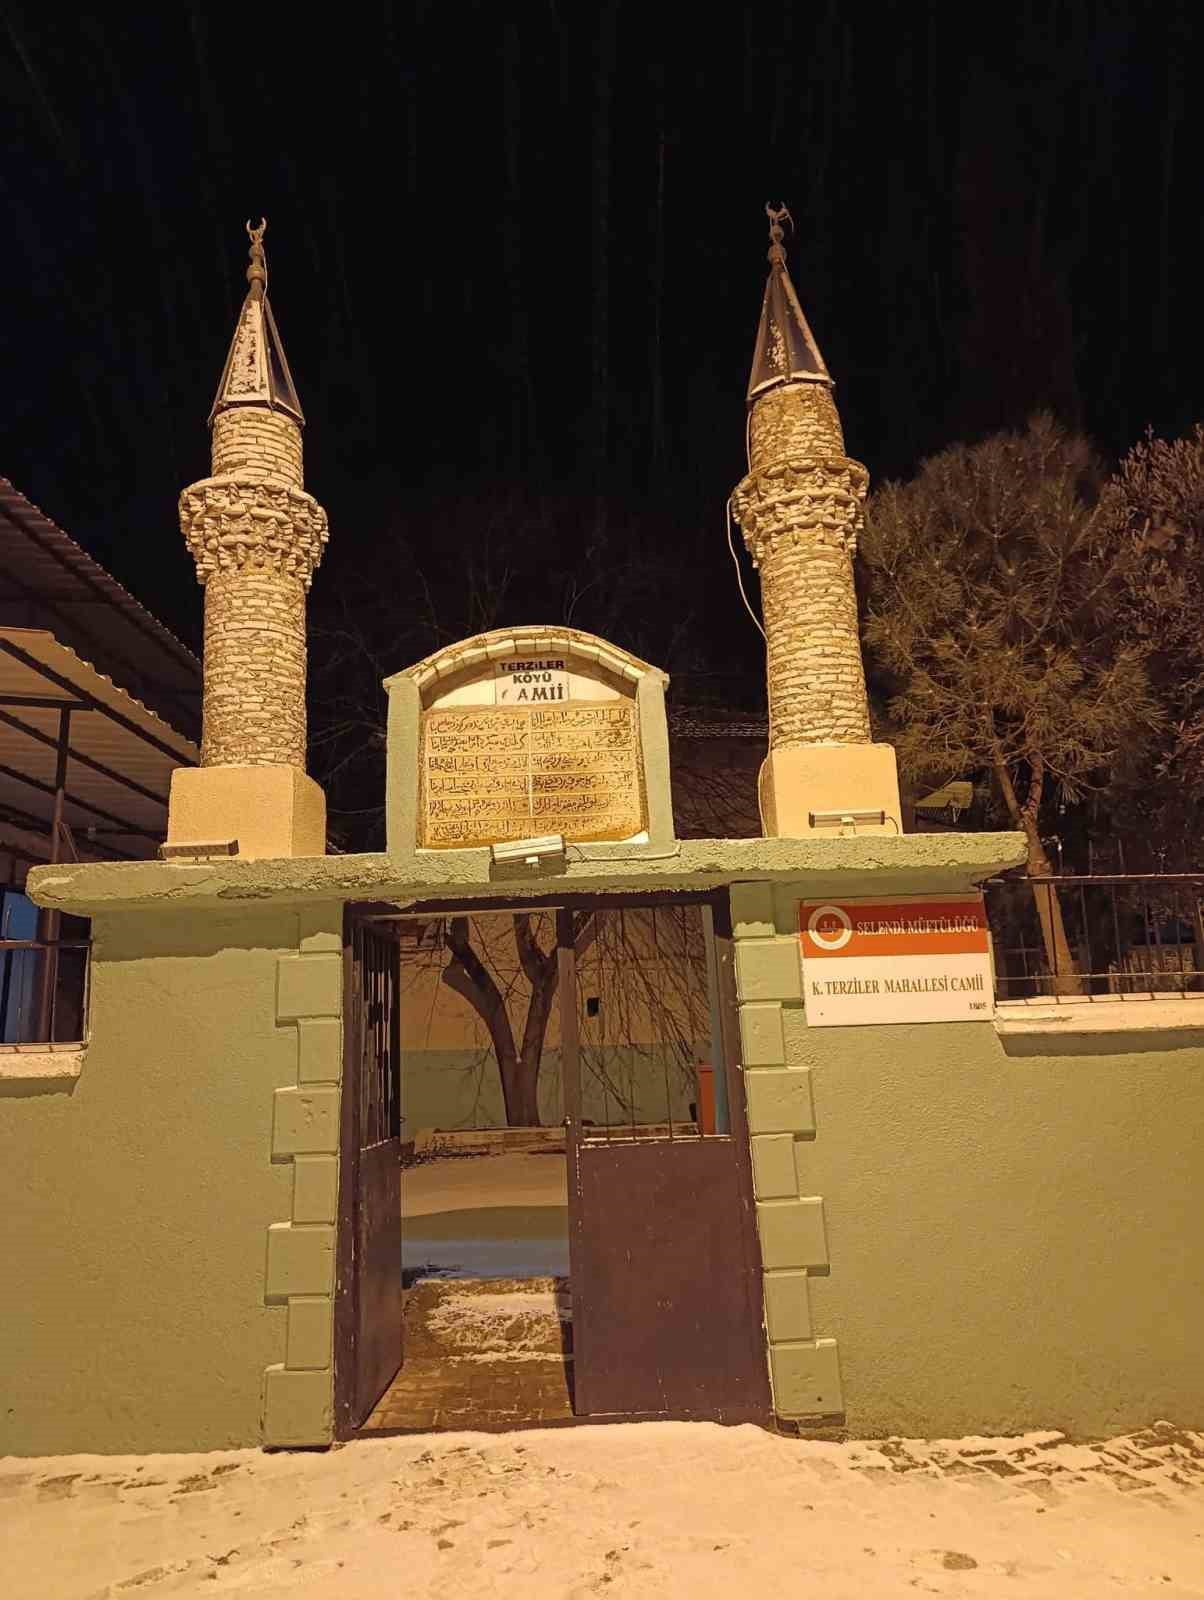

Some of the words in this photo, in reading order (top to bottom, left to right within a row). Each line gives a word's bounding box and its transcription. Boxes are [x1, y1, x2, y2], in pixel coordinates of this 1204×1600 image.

[513, 672, 552, 684] KÖYÜ
[502, 683, 564, 701] AMİİ
[857, 917, 907, 936] SELENDİ
[908, 914, 978, 934] MÜFTÜLÜĞÜ
[812, 981, 823, 995] K.
[824, 977, 880, 995] TERZİLER
[884, 975, 948, 993] MAHALLESİ
[951, 973, 984, 992] CAMİİ
